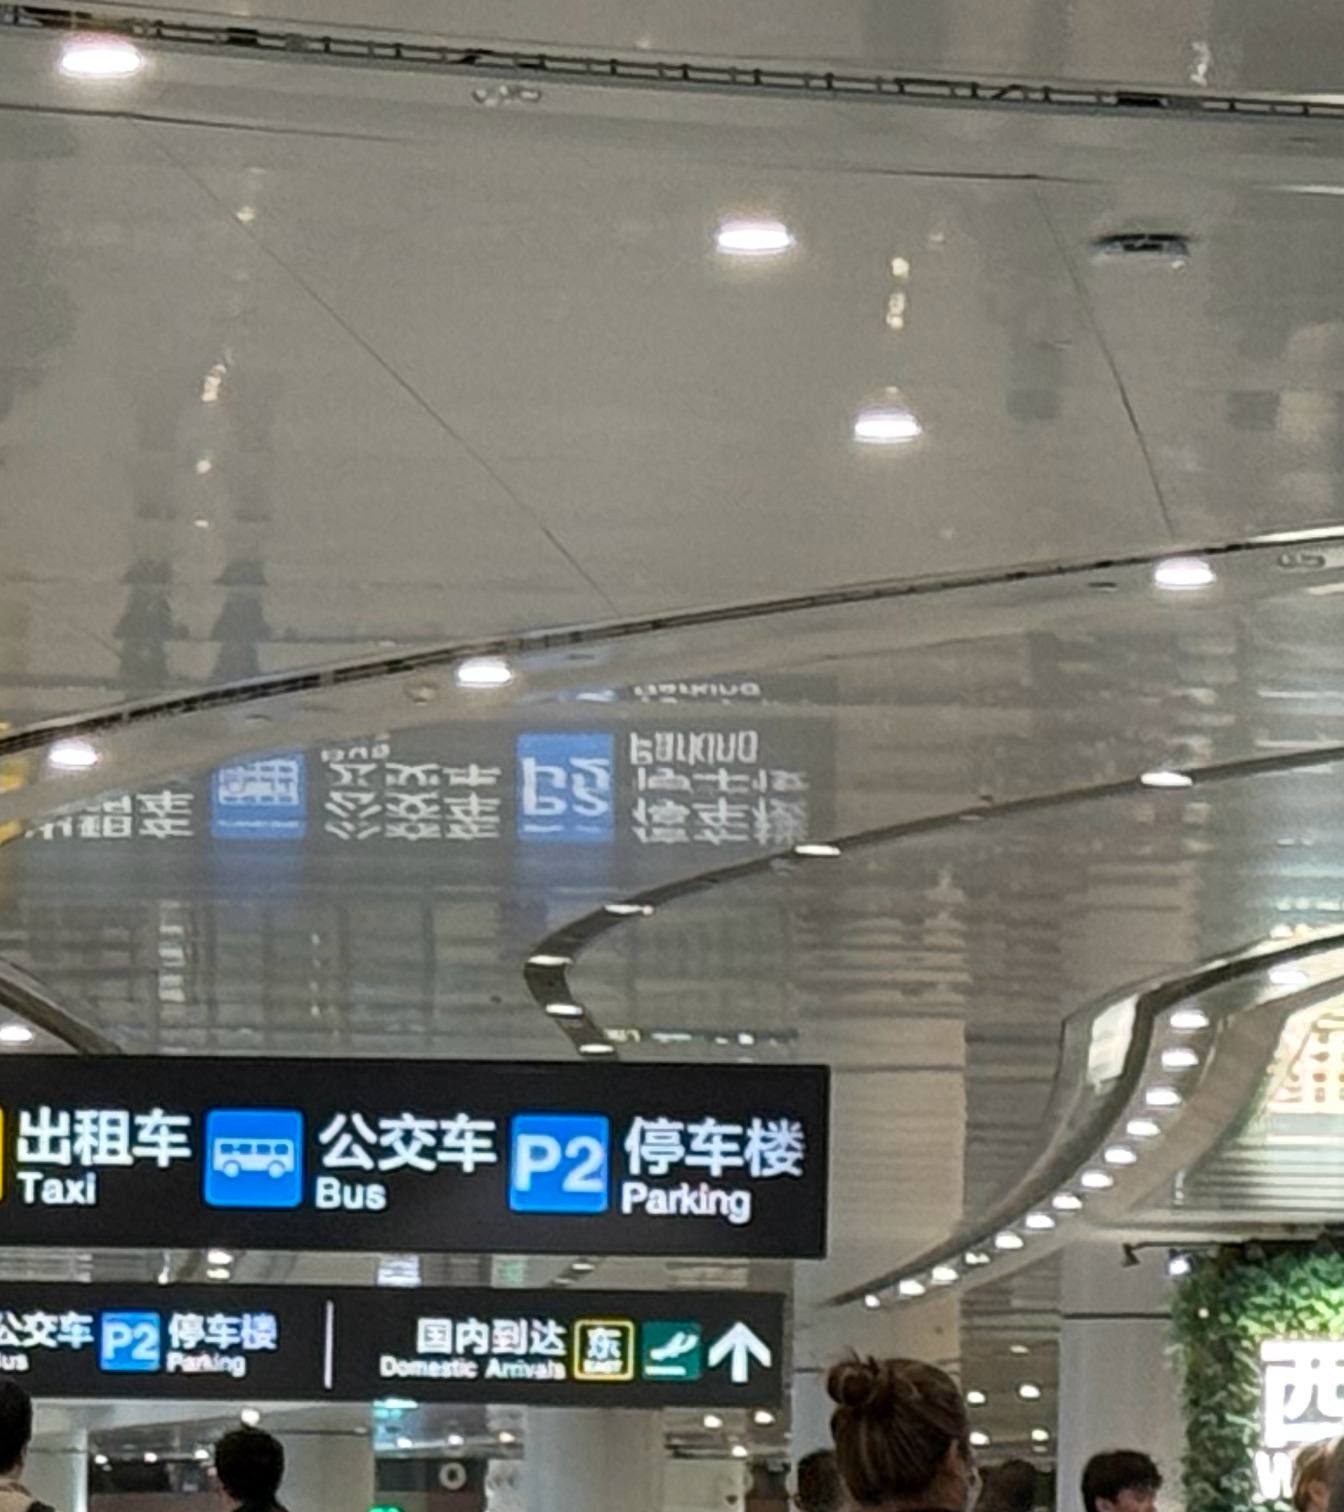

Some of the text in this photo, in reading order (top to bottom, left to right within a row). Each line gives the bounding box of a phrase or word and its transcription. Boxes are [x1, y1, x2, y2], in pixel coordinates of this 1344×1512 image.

[16, 1105, 192, 1168] 出租车
[318, 1112, 498, 1173] 公交车
[624, 1116, 803, 1177] 停车楼
[516, 1135, 605, 1192] P2
[16, 1171, 96, 1205] Taxi
[316, 1176, 387, 1210] Bus
[622, 1182, 751, 1224] Parking
[102, 1324, 159, 1360] P2
[168, 1312, 278, 1350] 停车楼
[416, 1317, 567, 1356] 国内到达
[587, 1327, 622, 1359] 东
[166, 1350, 246, 1378] Parking
[379, 1354, 567, 1381] Domestic Arrivals
